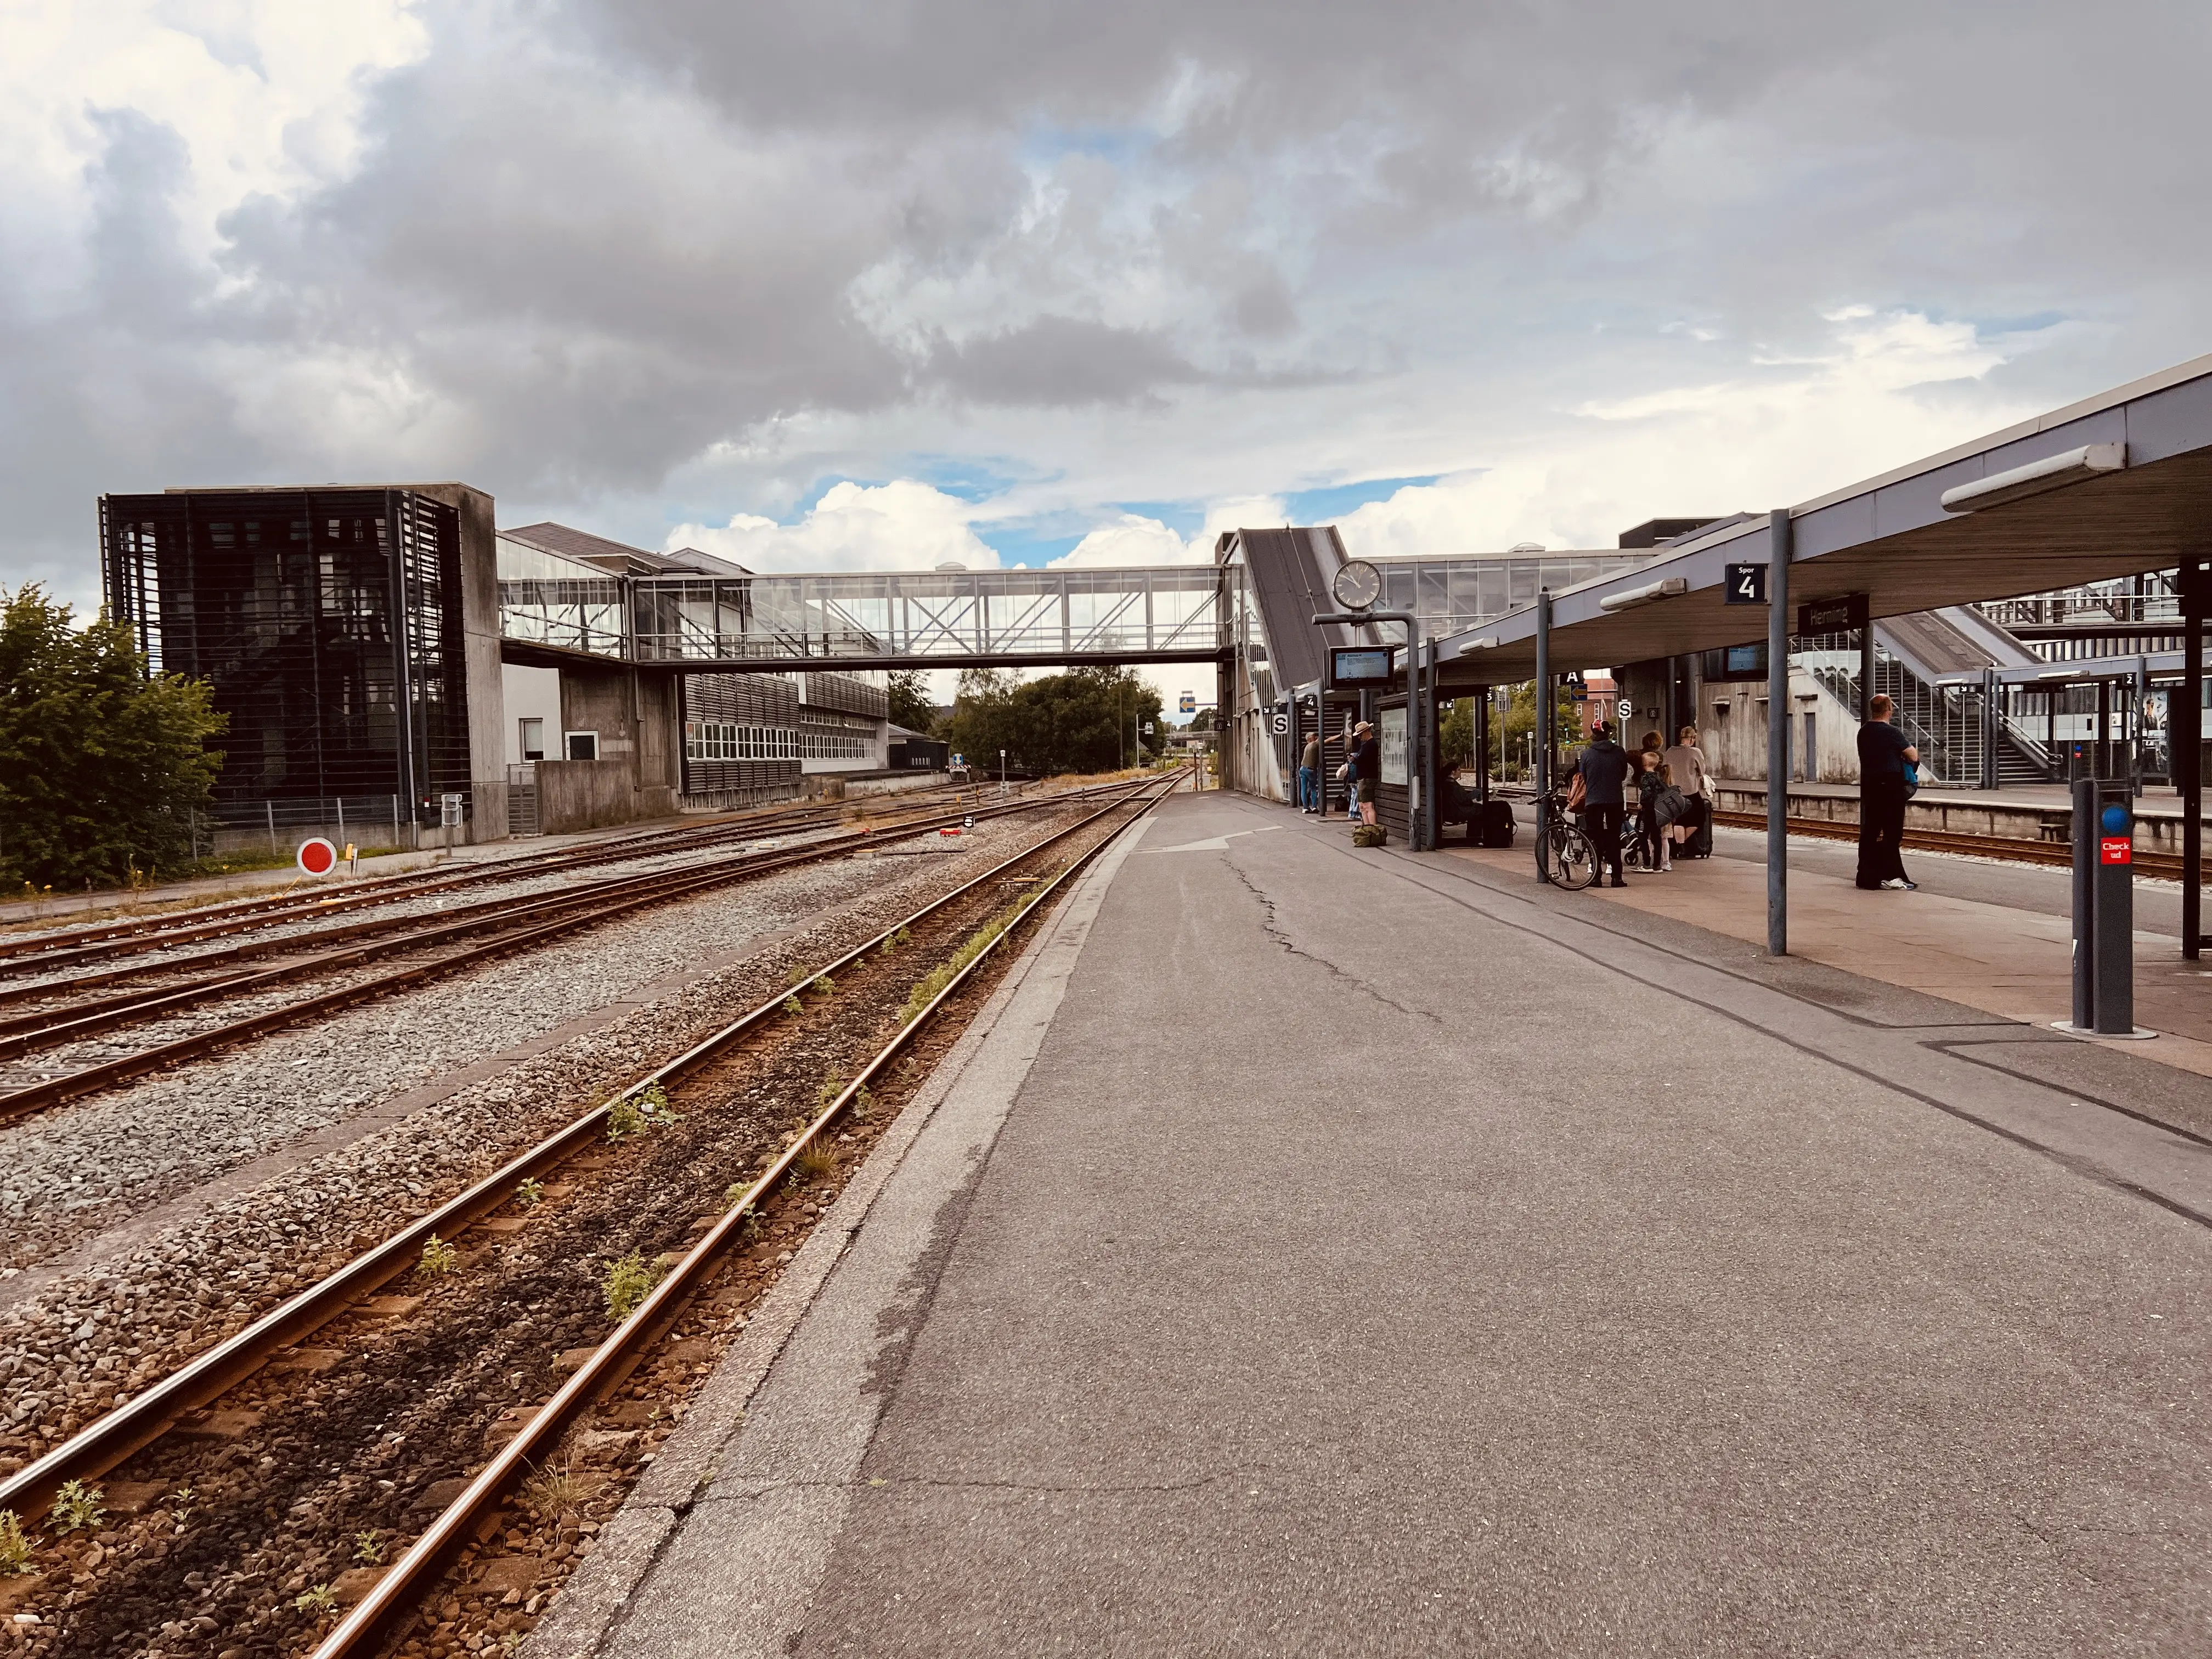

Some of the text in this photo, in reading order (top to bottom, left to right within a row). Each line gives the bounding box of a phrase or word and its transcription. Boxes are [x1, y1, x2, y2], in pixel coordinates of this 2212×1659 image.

[1739, 575, 1754, 598] 4
[1566, 672, 1578, 682] A
[2126, 676, 2132, 684] 2
[1487, 693, 1492, 701] 3
[1307, 698, 1314, 706] 4
[1620, 703, 1630, 716] S
[1274, 717, 1286, 732] S
[2102, 842, 2129, 850] Check
